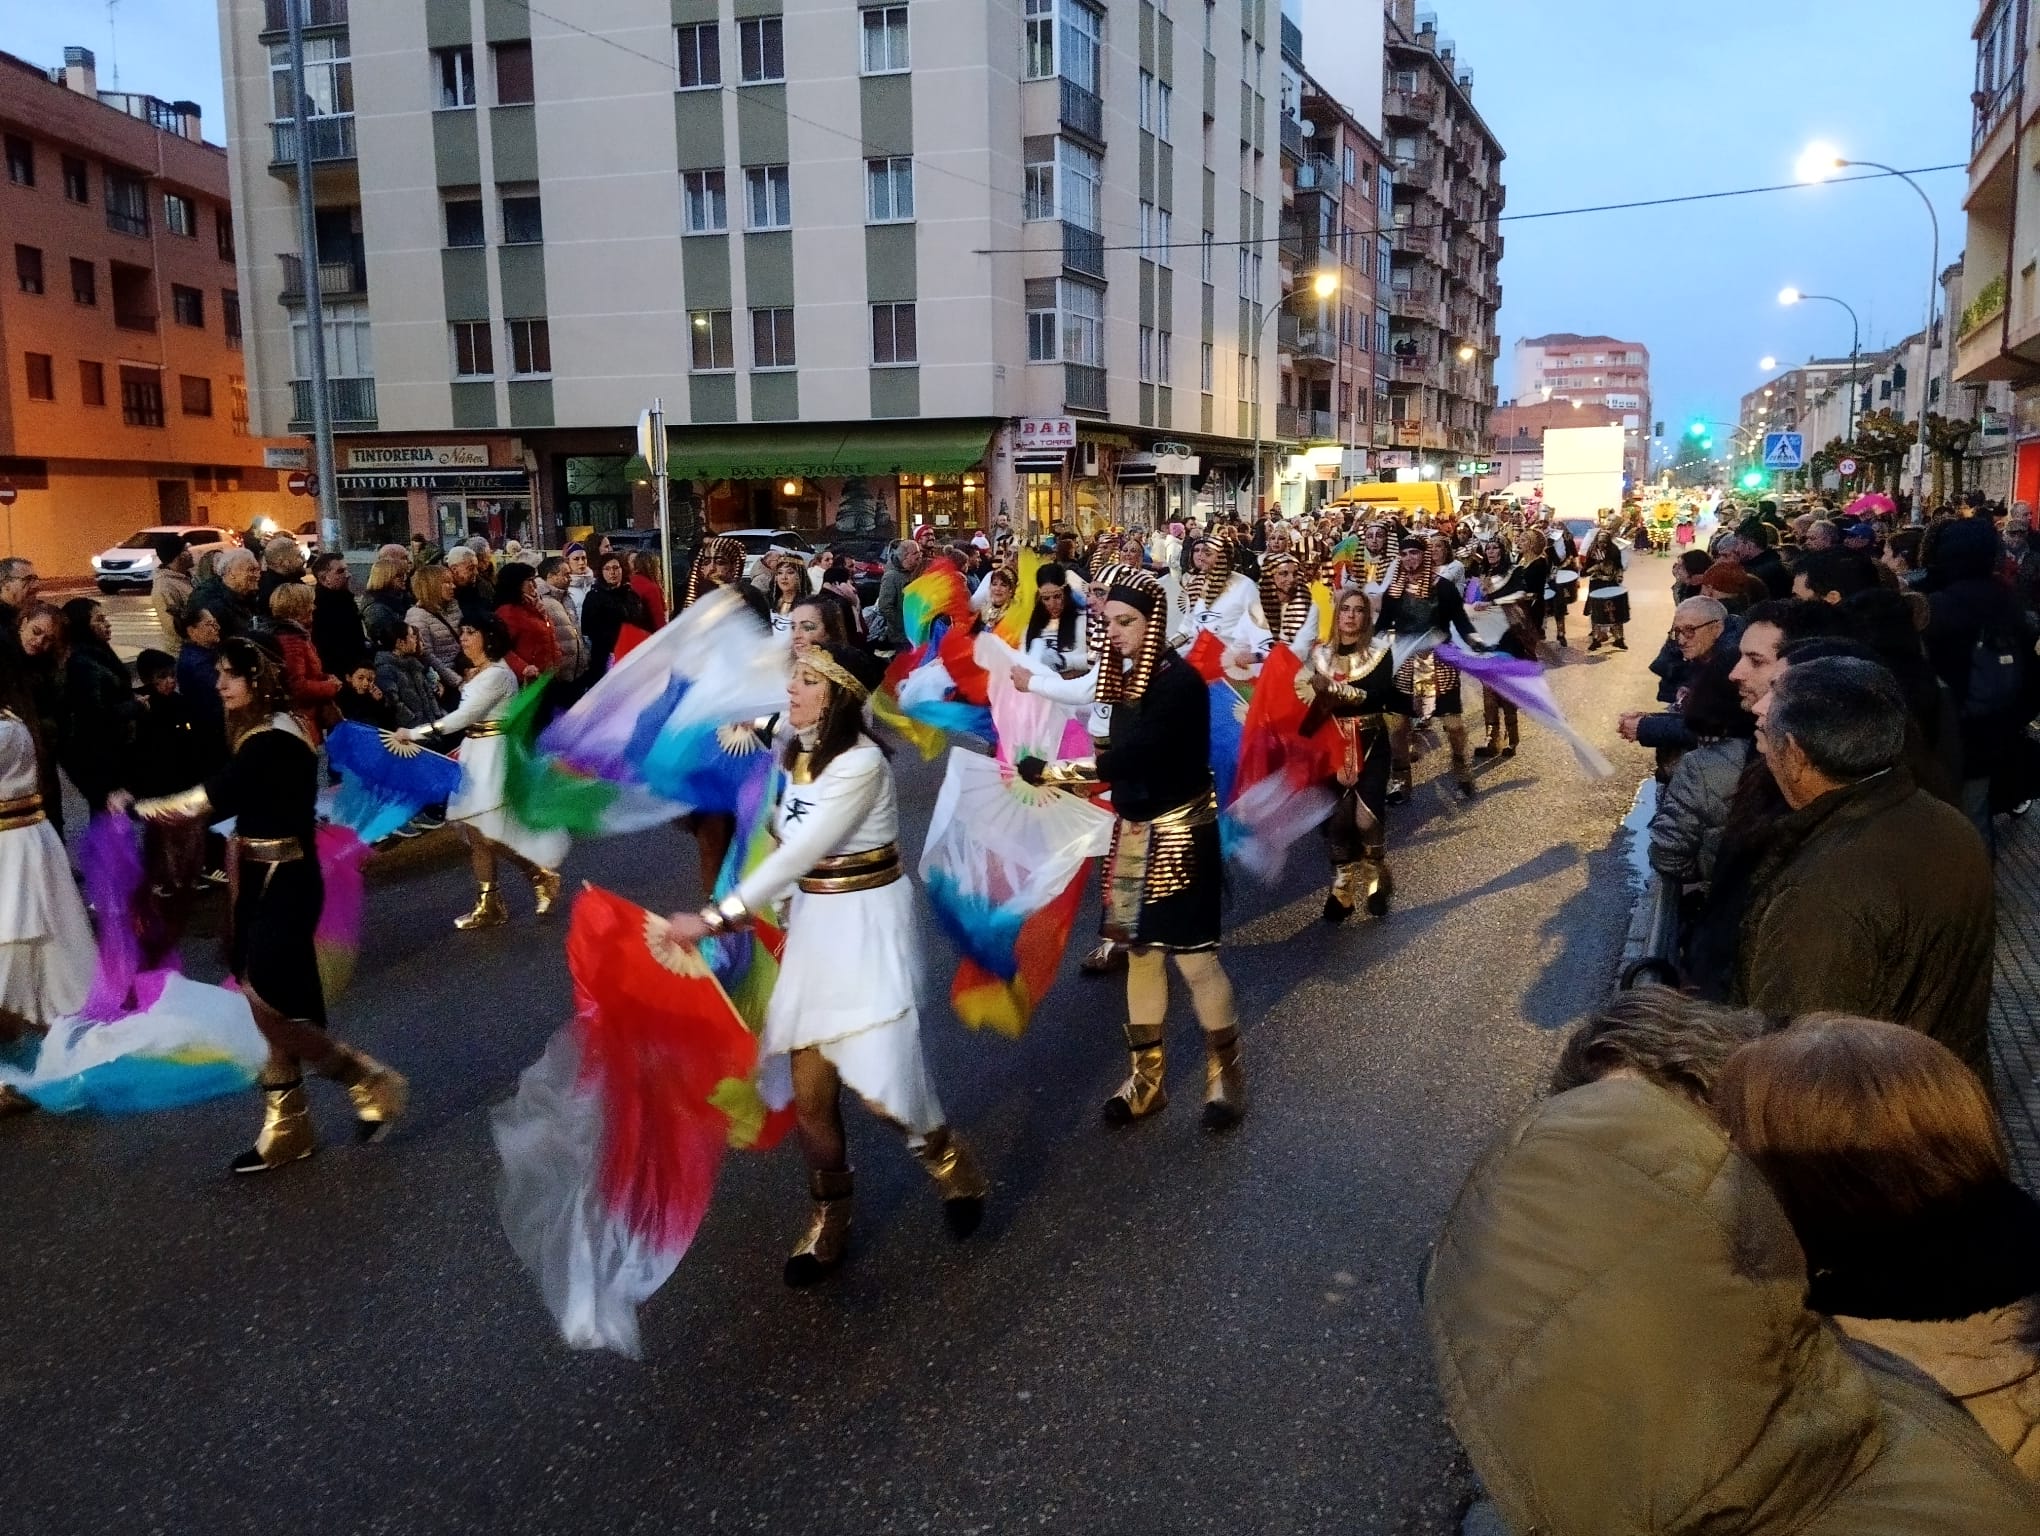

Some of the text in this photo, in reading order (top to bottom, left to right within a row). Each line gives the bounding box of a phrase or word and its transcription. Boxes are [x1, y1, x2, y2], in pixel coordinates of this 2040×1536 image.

[1023, 422, 1072, 436] BAR
[1022, 439, 1073, 447] LA TORRE
[352, 448, 434, 462] TINTORERIA
[343, 476, 437, 489] TINTORERIA
